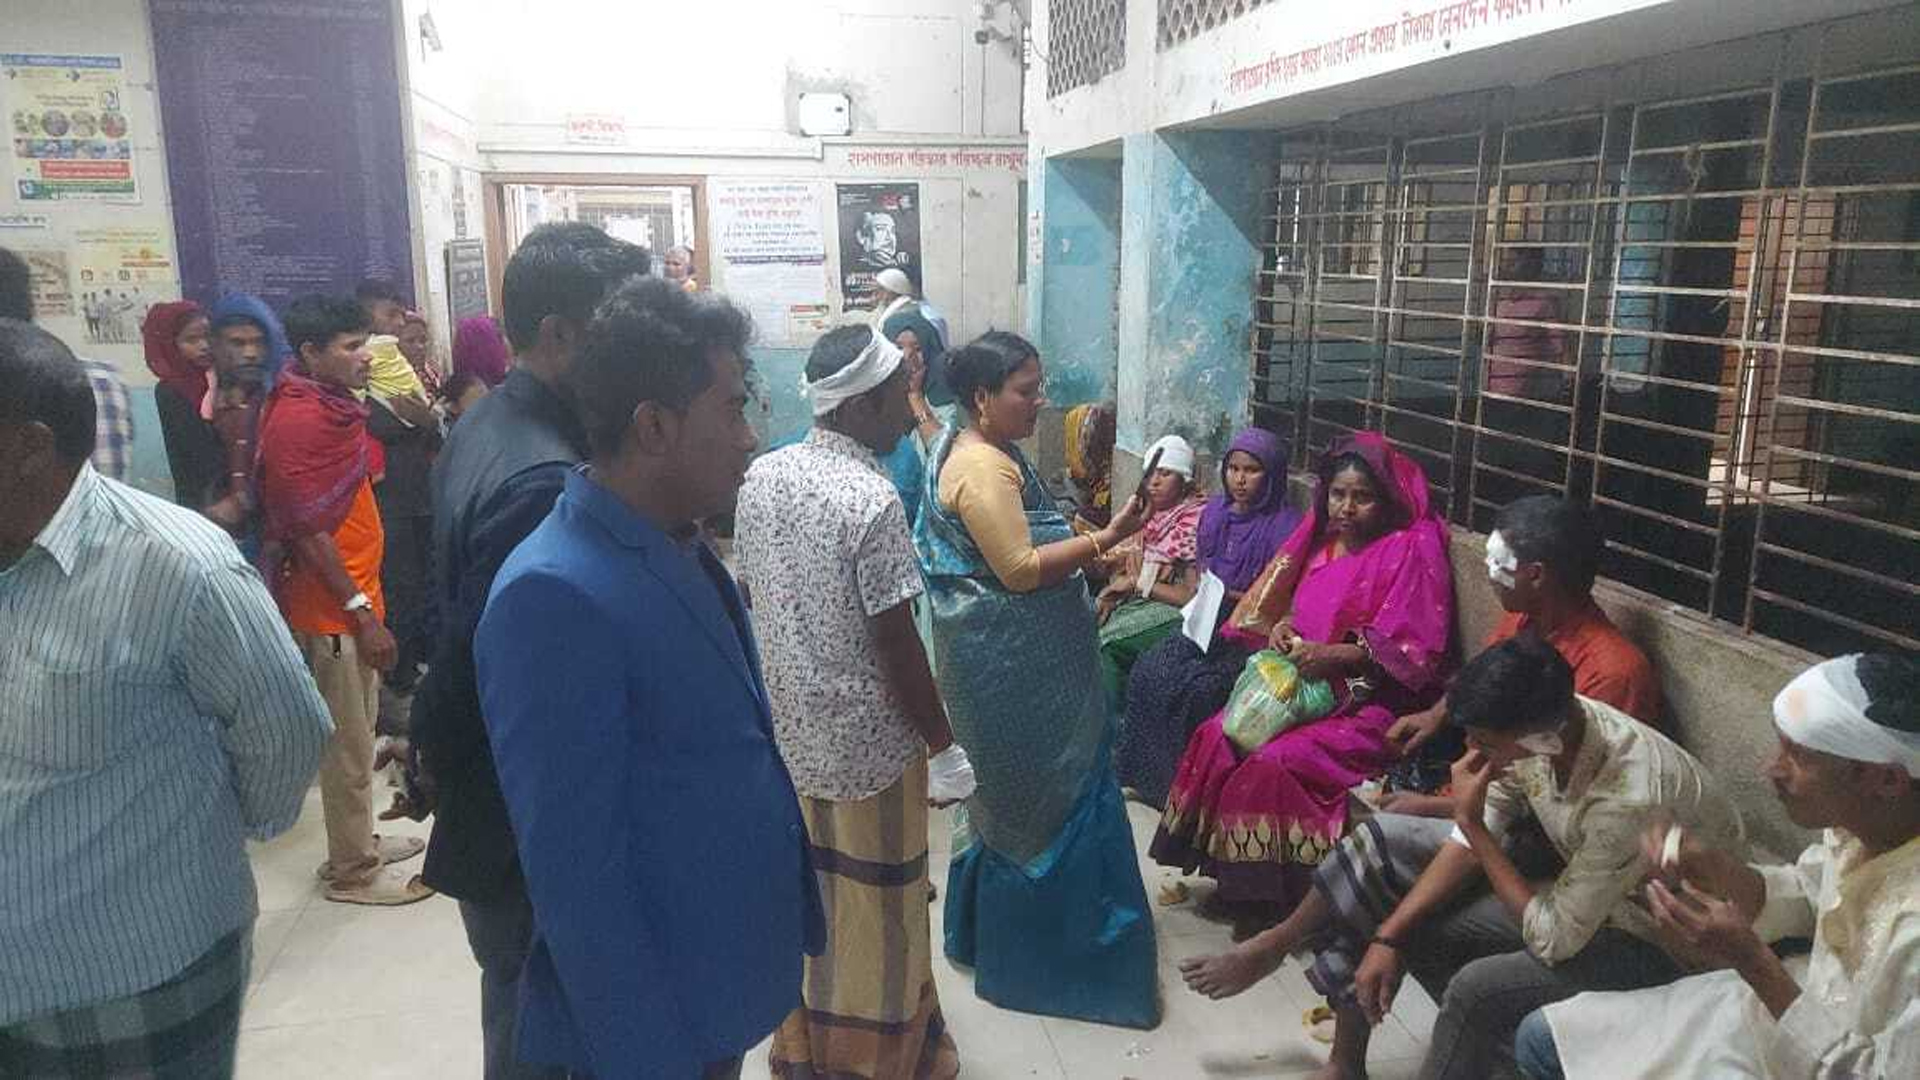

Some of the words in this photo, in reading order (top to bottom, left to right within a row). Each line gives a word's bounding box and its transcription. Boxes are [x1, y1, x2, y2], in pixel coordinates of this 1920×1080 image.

[1401, 10, 1437, 46] টাকার
[1438, 0, 1489, 37] লেনদেন
[849, 151, 903, 168] হাসপাতাল
